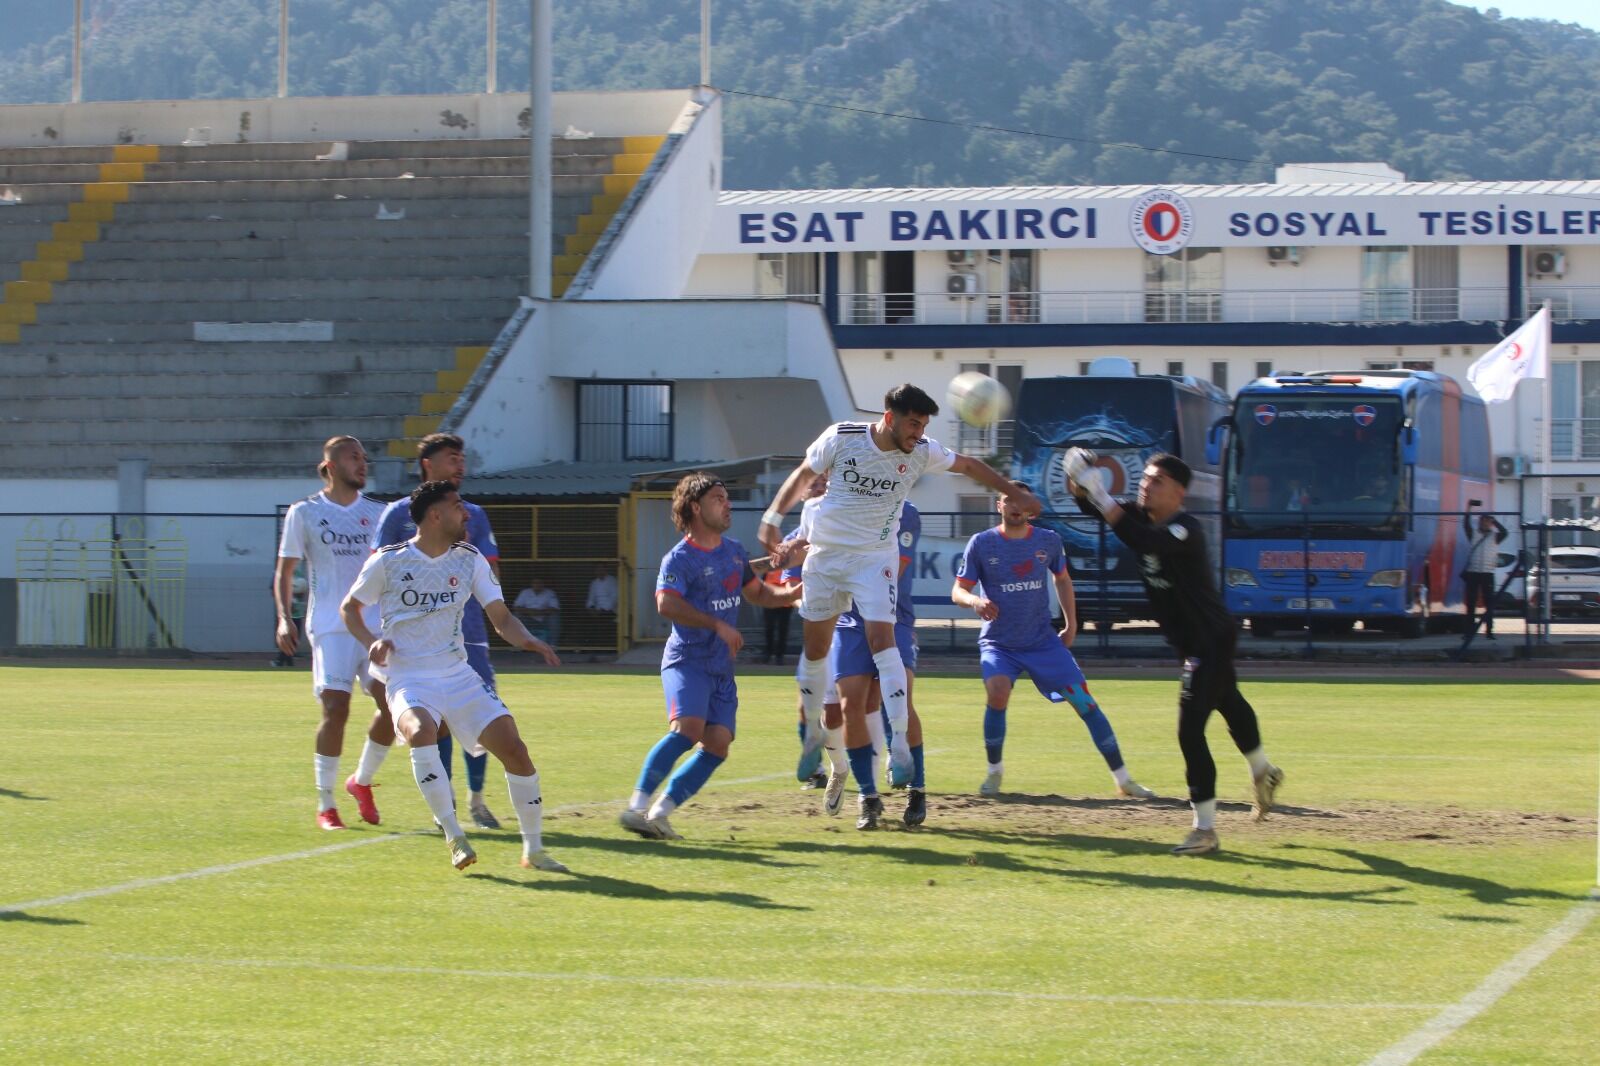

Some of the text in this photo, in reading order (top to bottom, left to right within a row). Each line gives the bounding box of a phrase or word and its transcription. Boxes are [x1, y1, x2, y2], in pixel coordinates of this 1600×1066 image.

[739, 211, 864, 244] ESAT
[890, 207, 1097, 241] BAKIRCI
[1229, 211, 1387, 237] SOSYAL
[843, 467, 900, 492] Özyer
[320, 528, 370, 547] Özyer
[401, 585, 458, 607] Özyer
